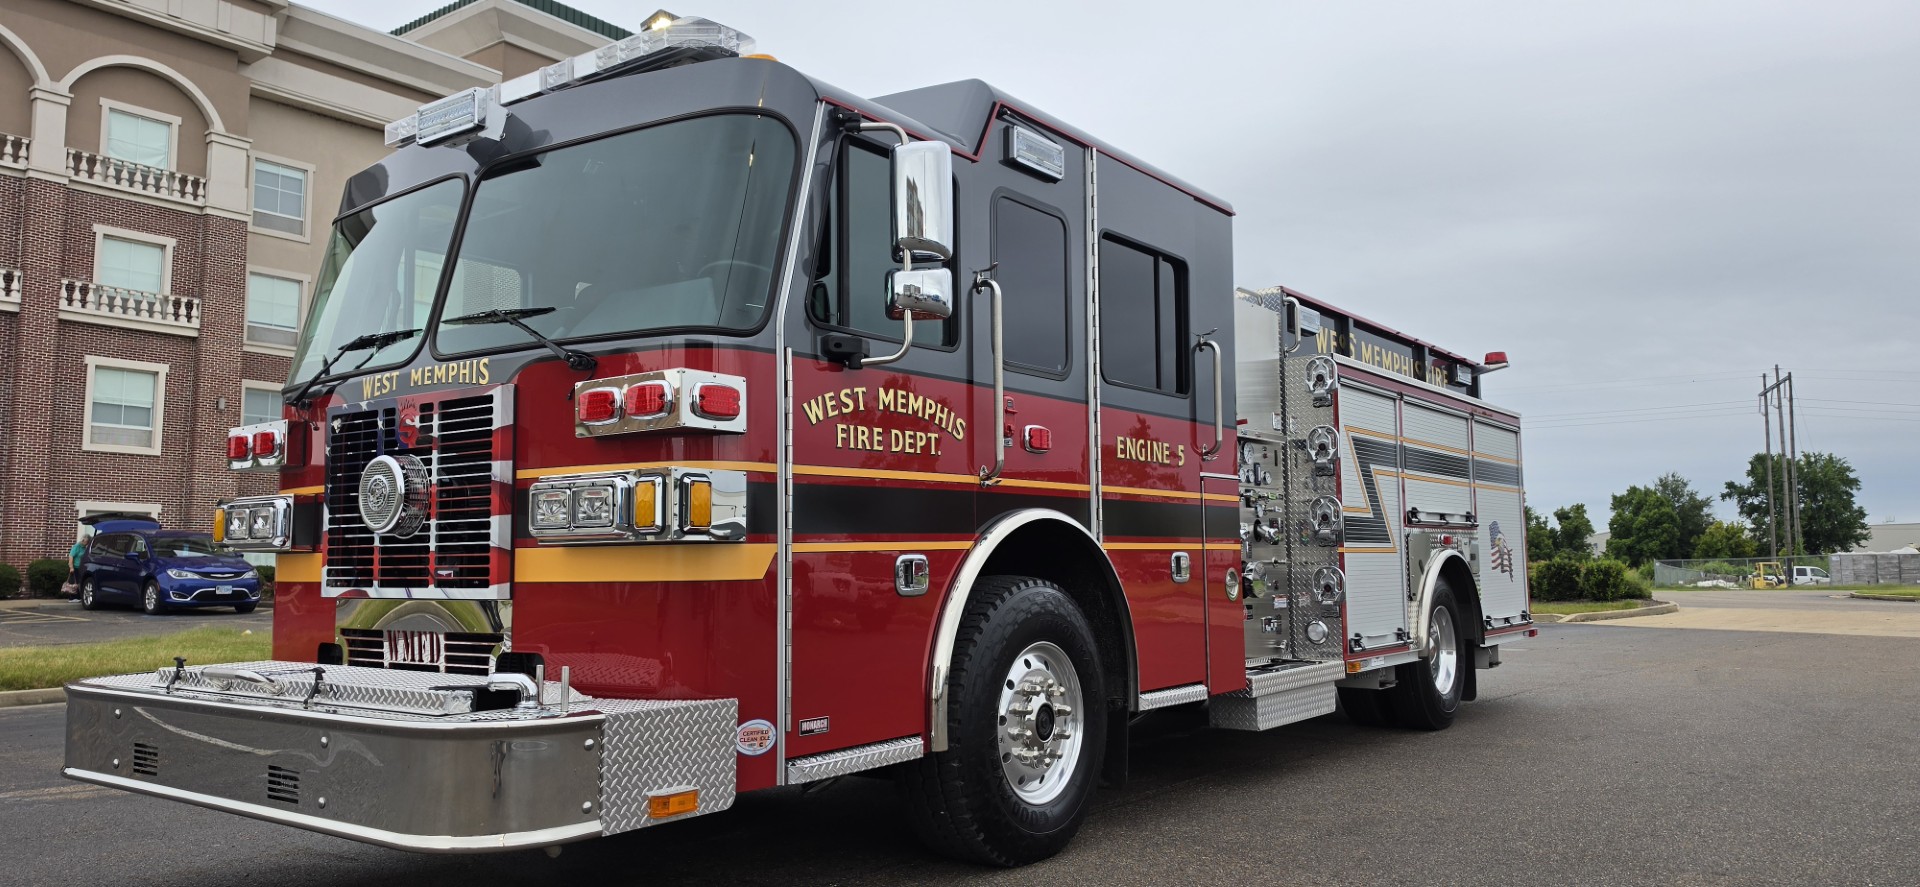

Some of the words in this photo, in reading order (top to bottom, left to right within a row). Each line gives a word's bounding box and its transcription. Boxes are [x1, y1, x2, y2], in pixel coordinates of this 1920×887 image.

[362, 371, 399, 400] WEST
[410, 357, 489, 386] MEMPHIS
[802, 386, 867, 426] WEST
[877, 386, 967, 441] MEMPHIS
[836, 423, 884, 452] FIRE
[890, 428, 942, 457] DEPT.
[1116, 435, 1171, 465] ENGINE
[1177, 444, 1185, 467] 5
[386, 629, 442, 664] WMFD
[801, 718, 828, 732] MONARCH
